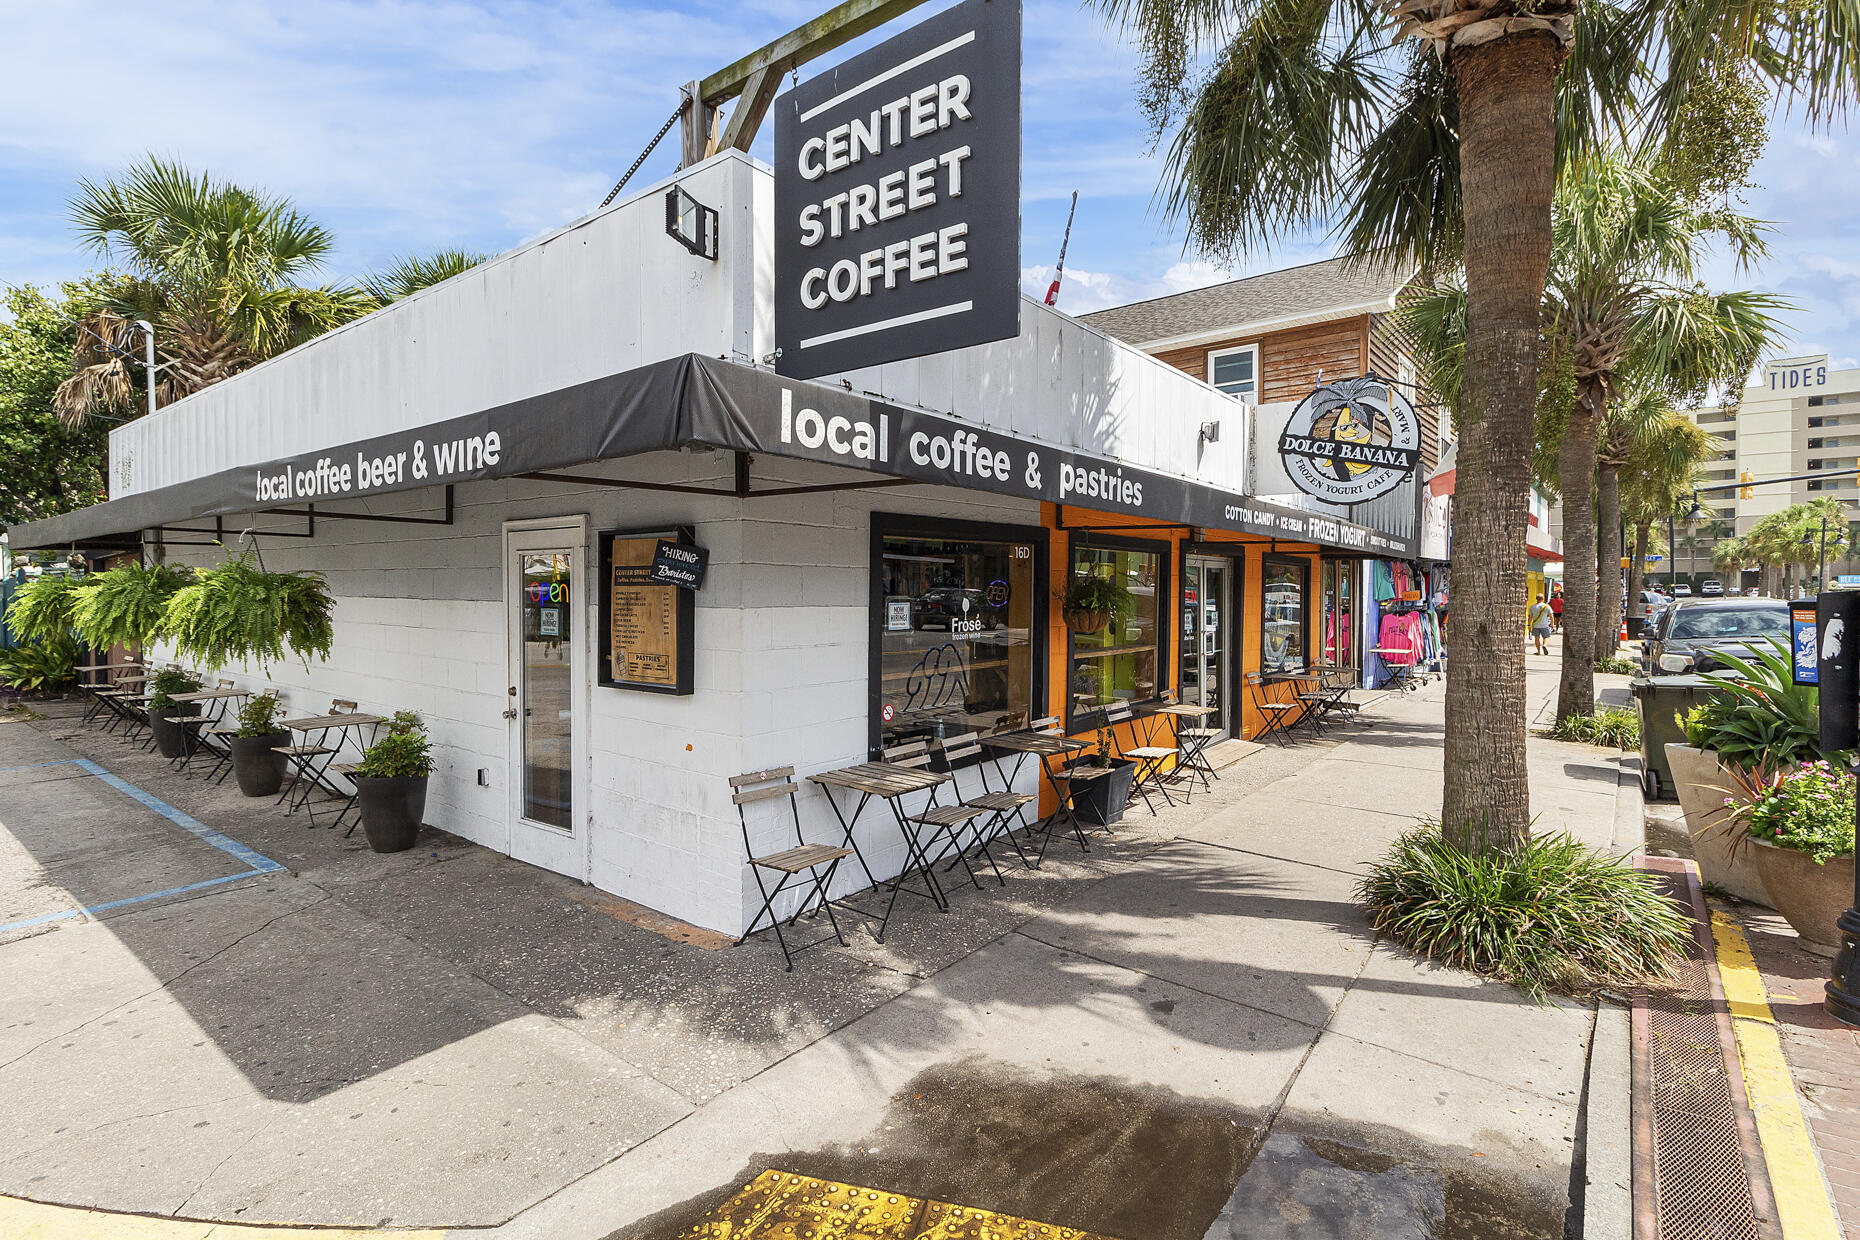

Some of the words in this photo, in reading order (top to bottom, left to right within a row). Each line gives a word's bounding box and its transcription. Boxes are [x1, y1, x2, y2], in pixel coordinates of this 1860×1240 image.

[798, 74, 972, 181] CENTER
[799, 145, 971, 247] STREET
[800, 222, 968, 310] COFFEE
[1770, 366, 1826, 390] TIDES
[256, 465, 292, 501] local
[296, 458, 351, 496] coffee
[358, 452, 406, 489] beer
[412, 439, 428, 479] &
[433, 431, 500, 475] wine
[780, 387, 888, 463] local
[909, 429, 1011, 482] coffee
[1024, 451, 1042, 490] &
[1059, 460, 1143, 507] pastries
[1283, 437, 1335, 456] DOLCE
[1339, 444, 1410, 467] BANANA
[1295, 458, 1324, 489] FROZEN
[1326, 484, 1364, 495] YOGURT
[1366, 469, 1394, 490] CAFE
[1391, 405, 1410, 433] MART
[1015, 546, 1030, 559] 16D
[1225, 505, 1252, 523] COTTON
[1254, 510, 1275, 526] CANDY
[1280, 516, 1288, 530] ICE
[1288, 518, 1303, 532] CREAM
[1308, 517, 1339, 543] FROZEN
[1340, 525, 1366, 547] YOGURT
[662, 546, 699, 563] HIRING
[635, 654, 661, 662] PASTRIES
